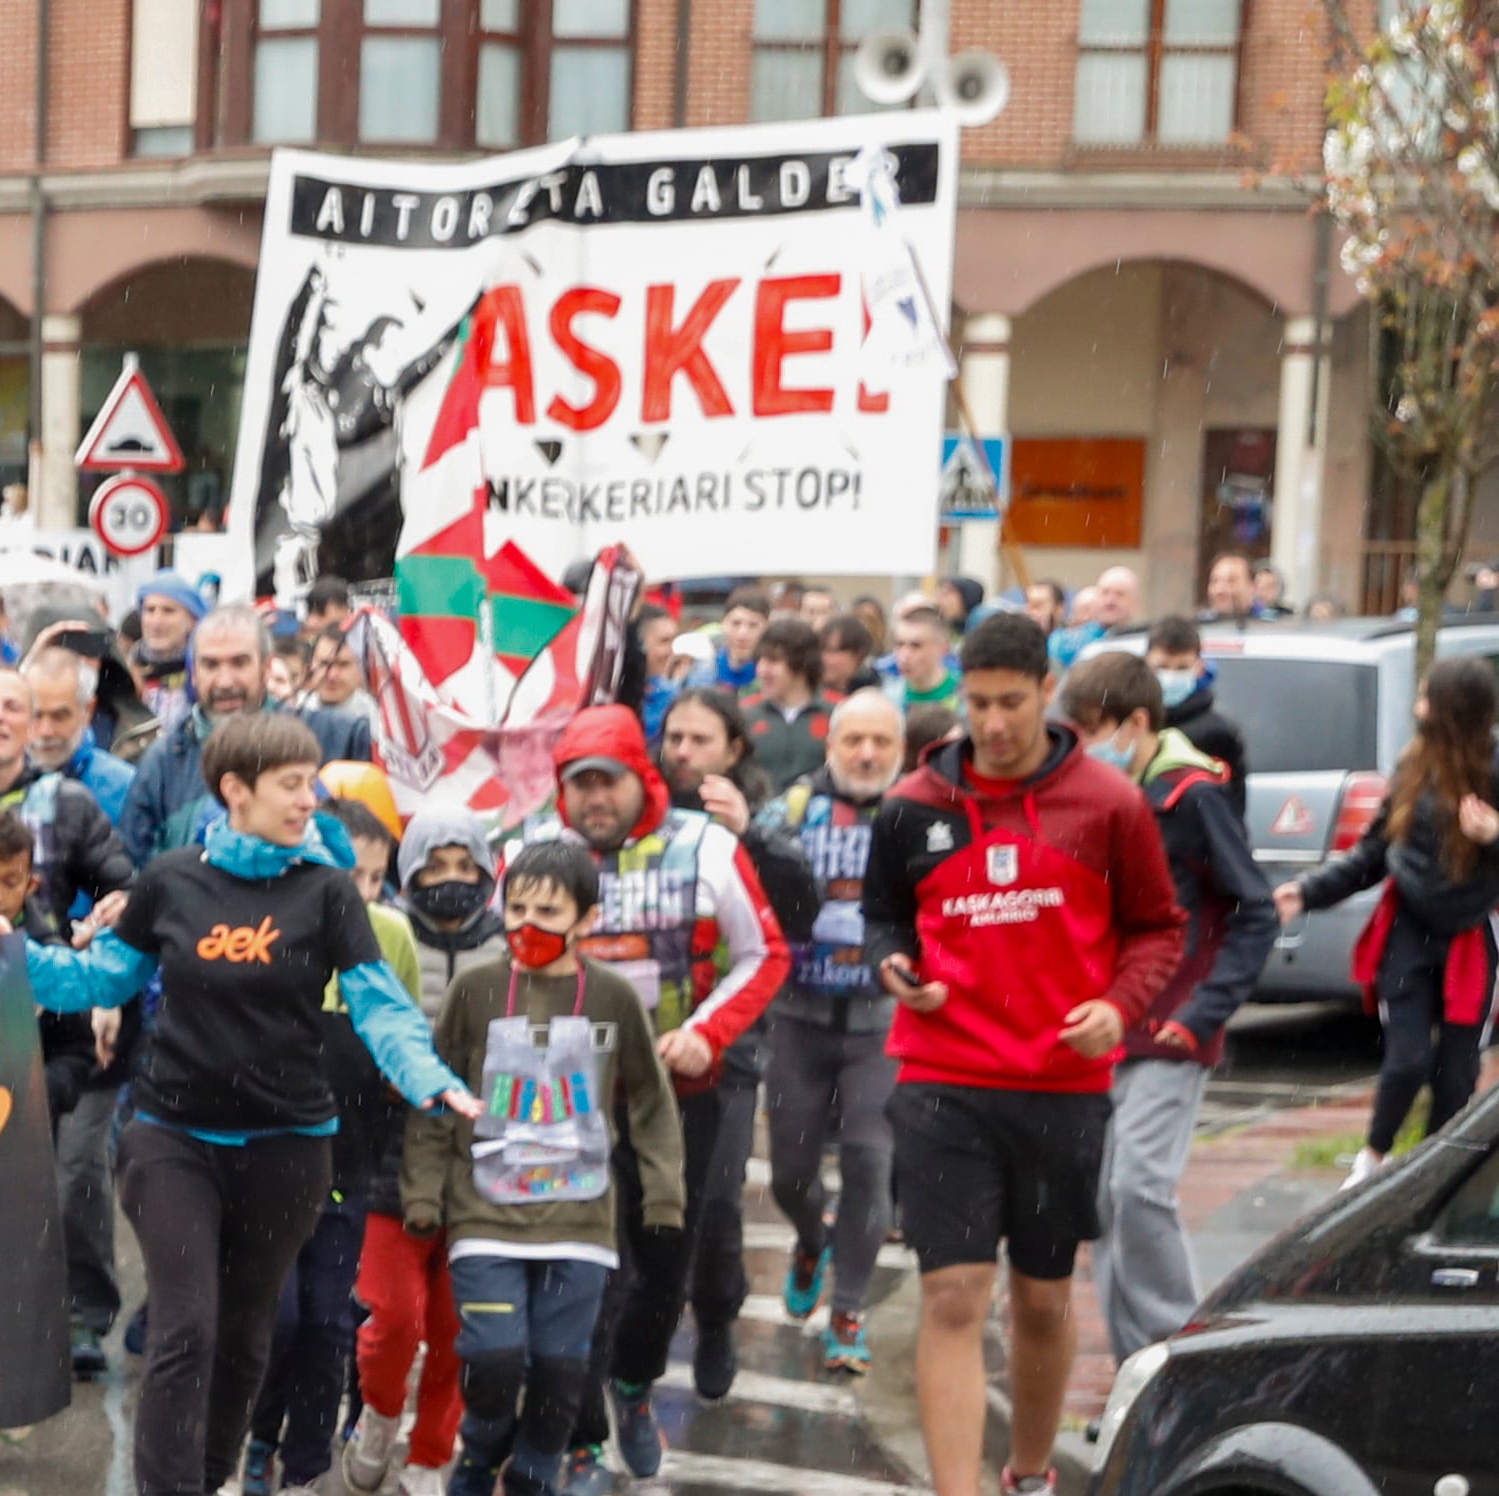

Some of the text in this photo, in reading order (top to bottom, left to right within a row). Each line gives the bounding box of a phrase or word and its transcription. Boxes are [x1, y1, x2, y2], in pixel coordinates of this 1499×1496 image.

[743, 467, 863, 513] STOP!
[109, 503, 151, 532] 30
[196, 913, 281, 966] aek
